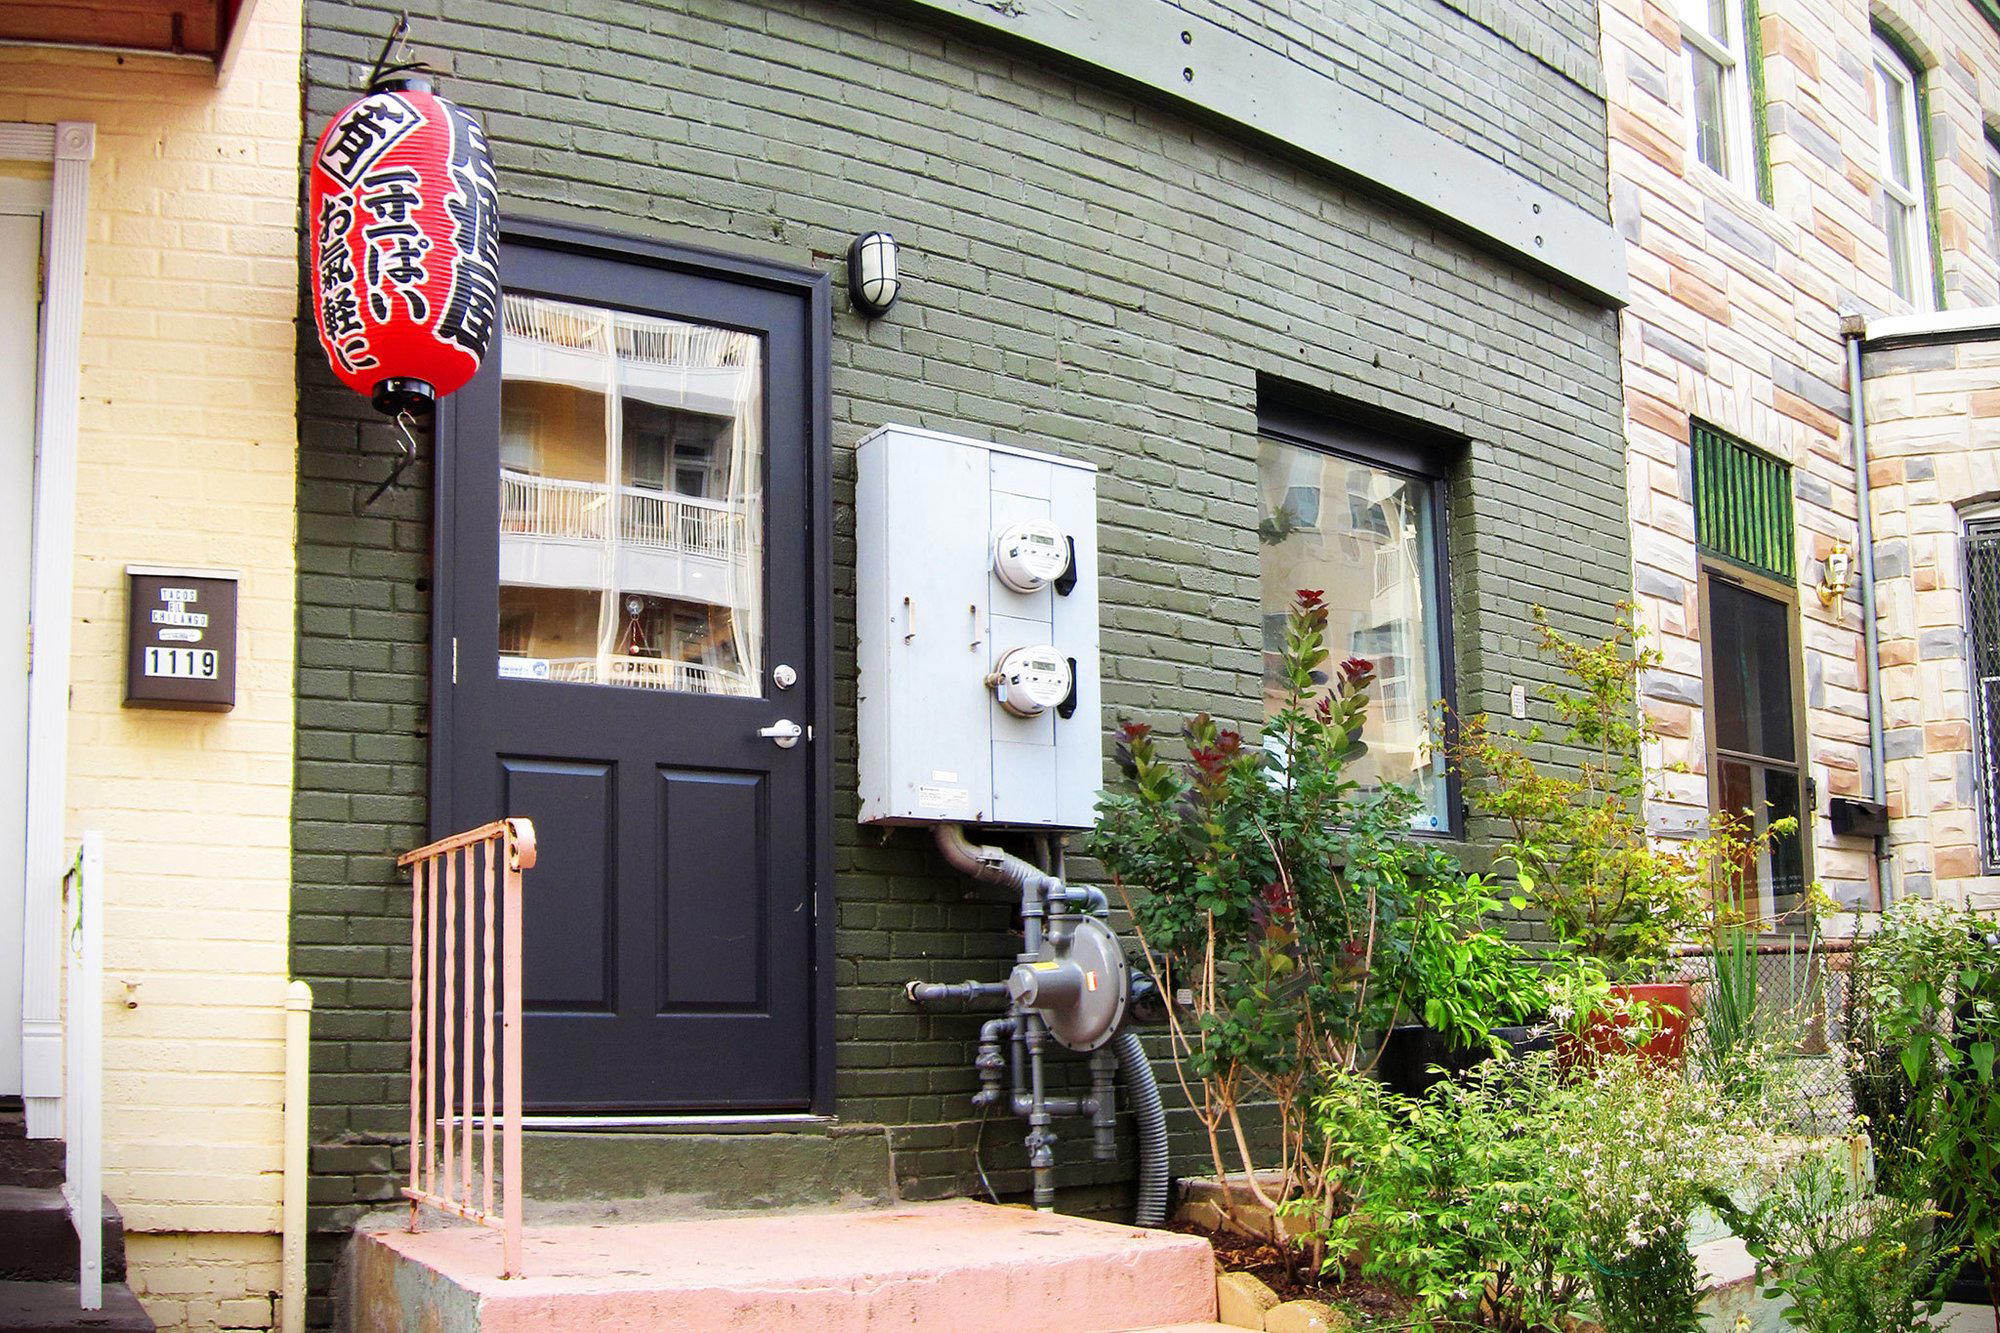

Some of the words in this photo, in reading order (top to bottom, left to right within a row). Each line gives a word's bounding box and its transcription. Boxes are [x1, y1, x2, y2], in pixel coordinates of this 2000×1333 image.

[162, 590, 195, 600] TACOS
[169, 602, 182, 613] EL
[153, 612, 206, 625] CHILANGO
[151, 650, 214, 676] 1119
